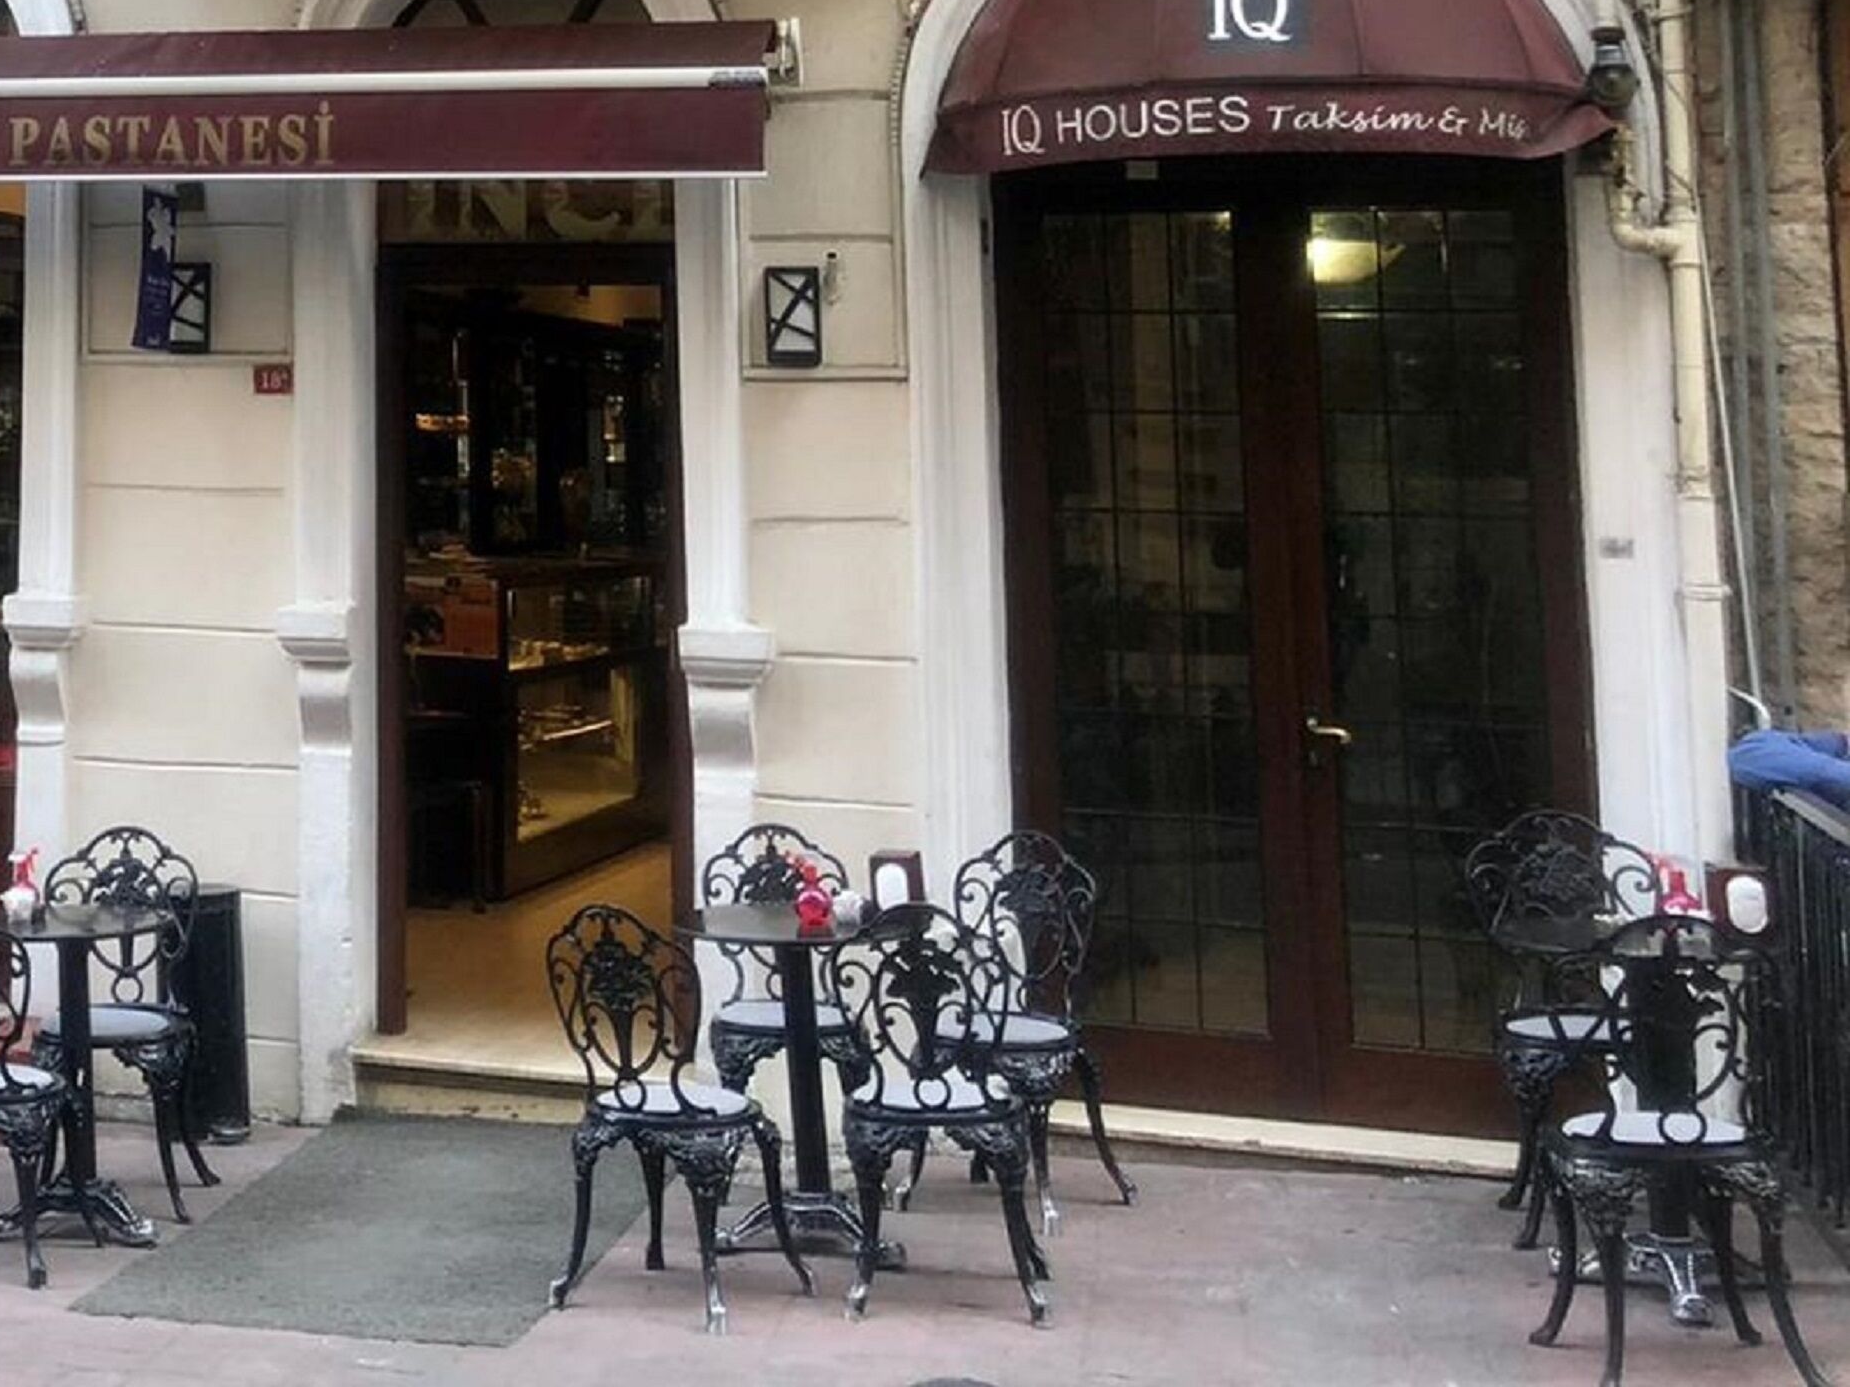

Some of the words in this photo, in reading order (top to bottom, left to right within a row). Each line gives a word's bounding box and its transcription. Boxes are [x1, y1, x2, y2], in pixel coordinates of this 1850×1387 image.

[8, 100, 335, 168] PASTANESİ
[1002, 104, 1045, 155] IQ
[1056, 96, 1251, 144] HOUSES
[1266, 101, 1435, 133] Taksim
